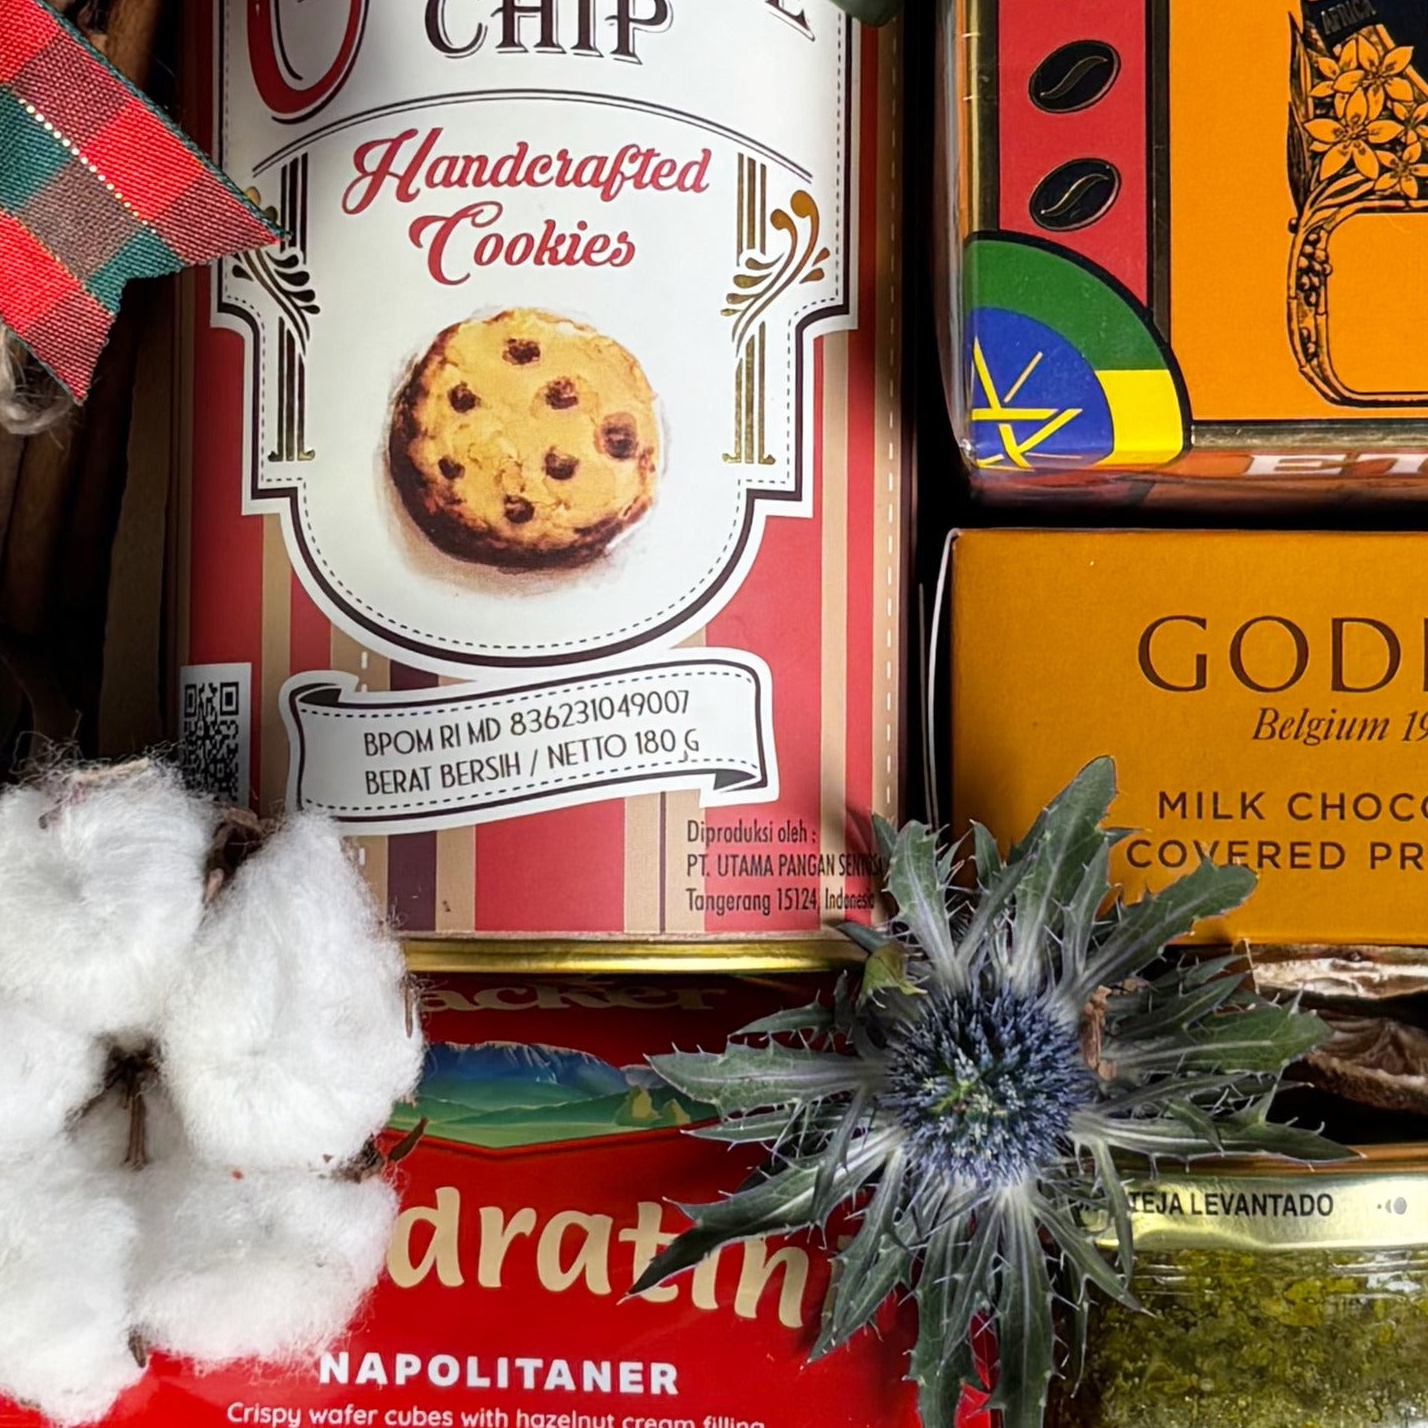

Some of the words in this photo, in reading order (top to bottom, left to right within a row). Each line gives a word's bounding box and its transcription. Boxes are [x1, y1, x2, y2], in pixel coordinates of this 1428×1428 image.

[341, 127, 713, 215] Handcrafted
[407, 200, 636, 286] Cookies
[364, 728, 434, 757] BPOM
[468, 718, 501, 745] MD
[510, 690, 689, 736] 836231049007
[1252, 707, 1390, 747] Belgium
[365, 766, 433, 796] BERAT
[441, 753, 521, 789] BERSIH
[548, 734, 627, 770] NETTO
[635, 729, 676, 758] 180
[1157, 791, 1267, 821] MILK
[687, 819, 773, 848] Diproduksi
[717, 854, 773, 877] UTAMA
[778, 854, 835, 876] PANGAN
[1126, 840, 1347, 872] COVERED
[685, 888, 771, 916] Tangerang
[825, 887, 875, 911] Indonesia
[420, 977, 727, 1010] acker
[1128, 1192, 1184, 1214] TEJA
[1191, 1193, 1334, 1217] LEVANTADO
[387, 1186, 808, 1328] dratin
[319, 1352, 678, 1395] NAPOLITANER
[227, 1401, 301, 1428] Crispy
[309, 1405, 377, 1425] wafer
[384, 1407, 453, 1428] cubes
[461, 1407, 508, 1428] with
